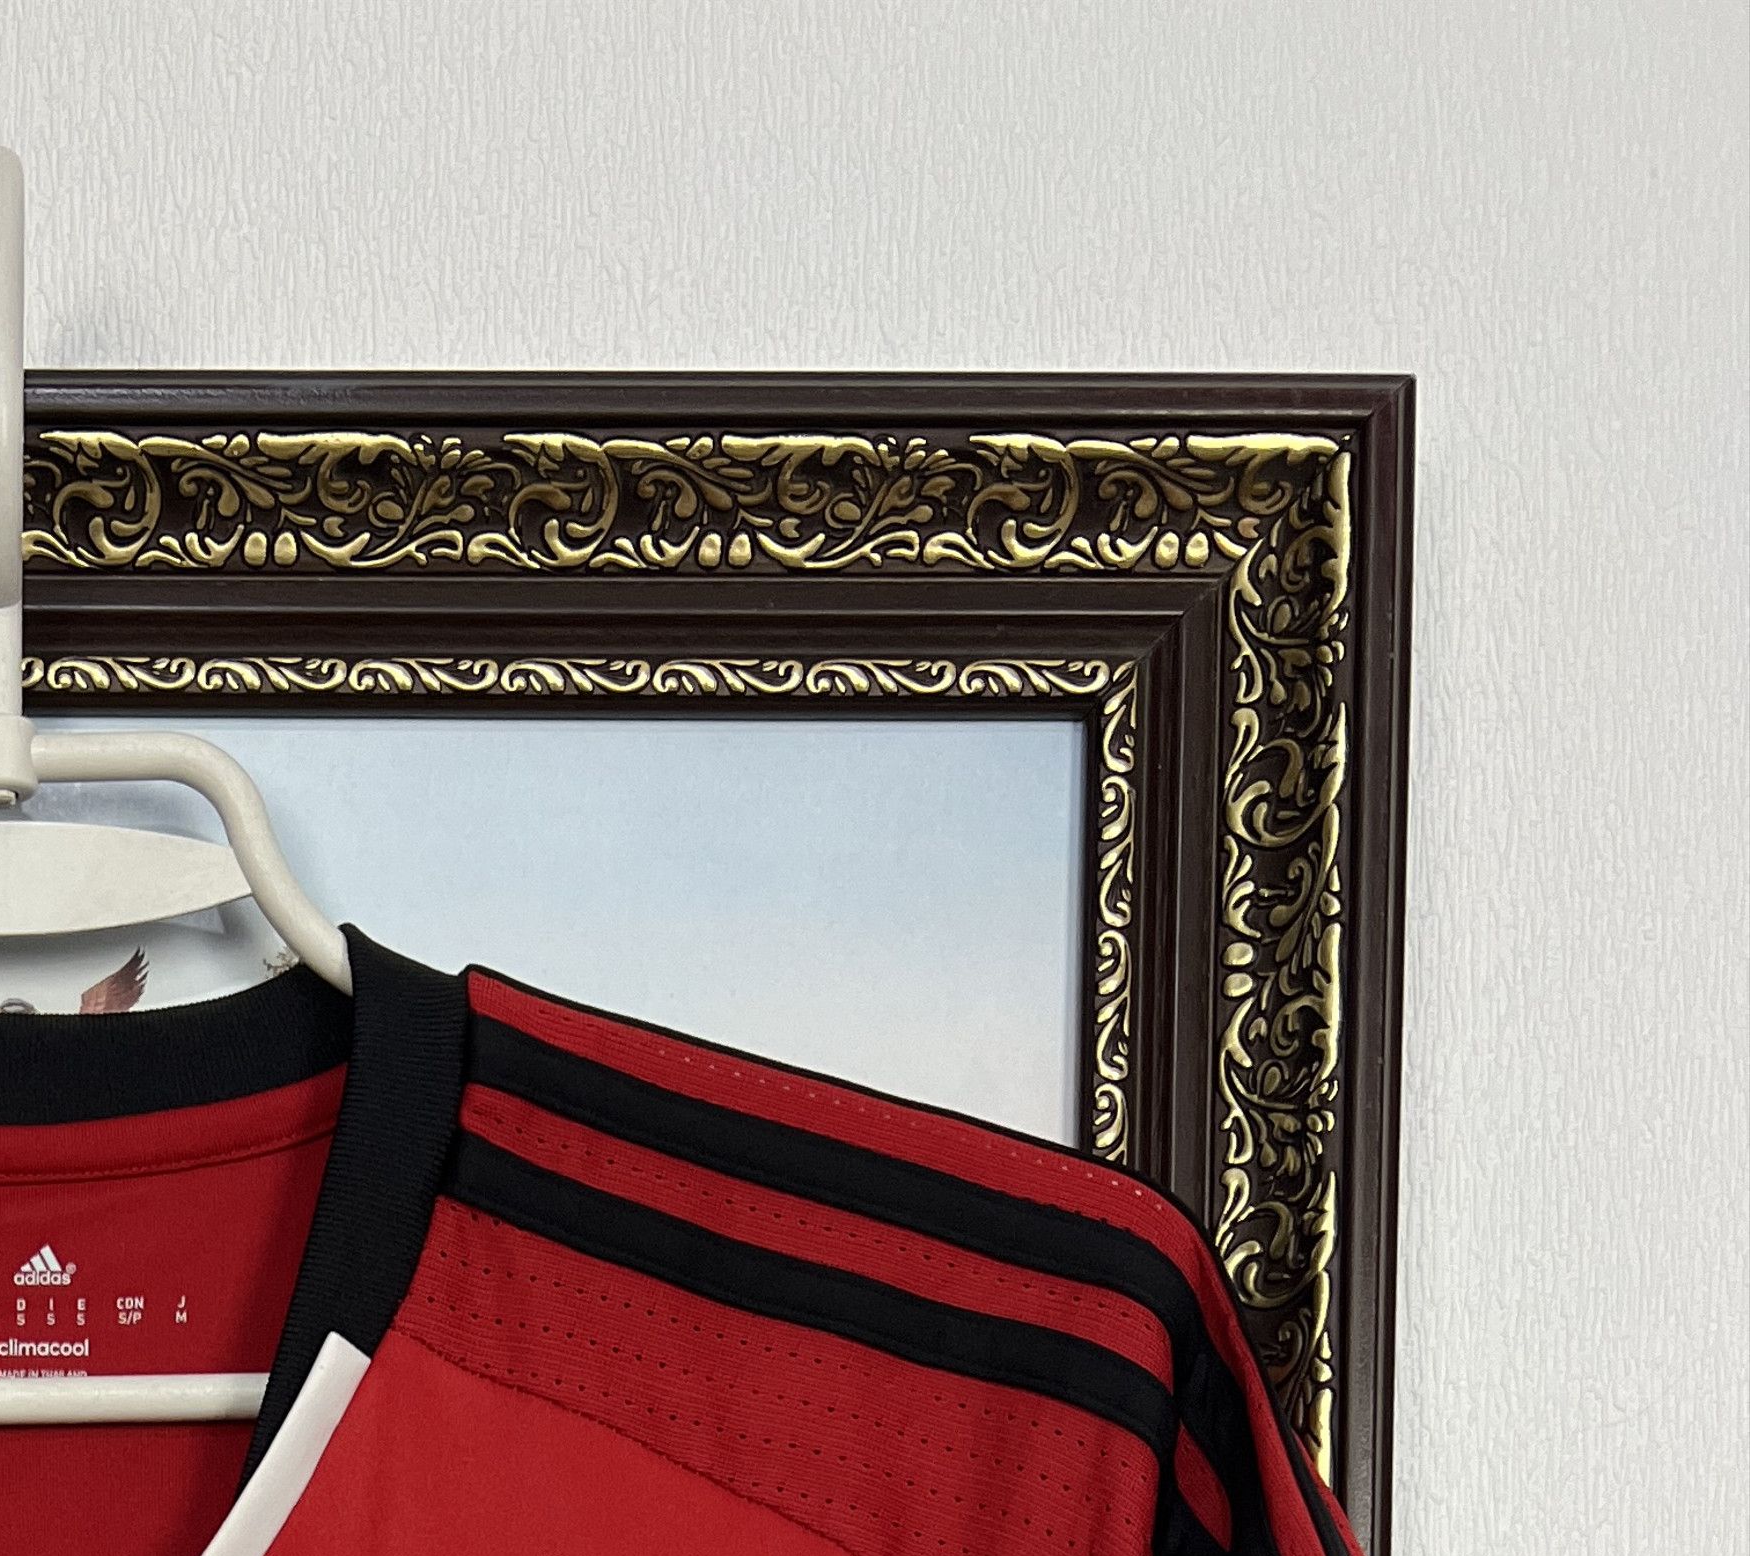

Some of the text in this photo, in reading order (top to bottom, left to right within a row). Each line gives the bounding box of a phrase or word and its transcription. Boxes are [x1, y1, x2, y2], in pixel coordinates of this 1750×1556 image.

[13, 1270, 72, 1286] adidas
[16, 1298, 26, 1311] D
[49, 1298, 54, 1311] I
[77, 1298, 86, 1311] E
[177, 1295, 186, 1309] J
[16, 1313, 26, 1326] S
[47, 1312, 56, 1326] S
[76, 1312, 86, 1326] S
[118, 1310, 142, 1325] S/P
[175, 1310, 187, 1324] M
